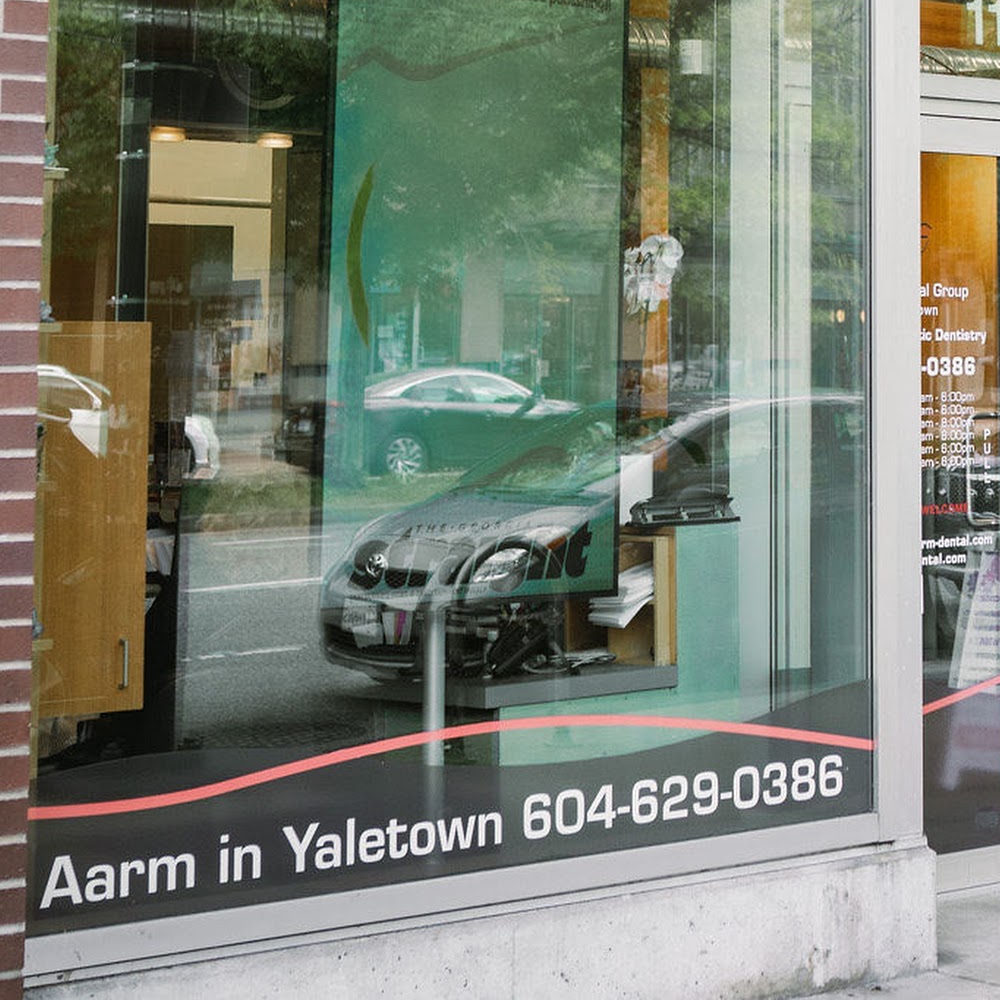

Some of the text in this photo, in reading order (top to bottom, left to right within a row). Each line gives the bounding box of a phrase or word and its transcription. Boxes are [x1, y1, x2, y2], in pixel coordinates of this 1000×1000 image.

[933, 283, 969, 301] Group
[935, 328, 986, 345] Dentistry
[39, 754, 843, 910] Aarm in Yaletown 604-629-0386
